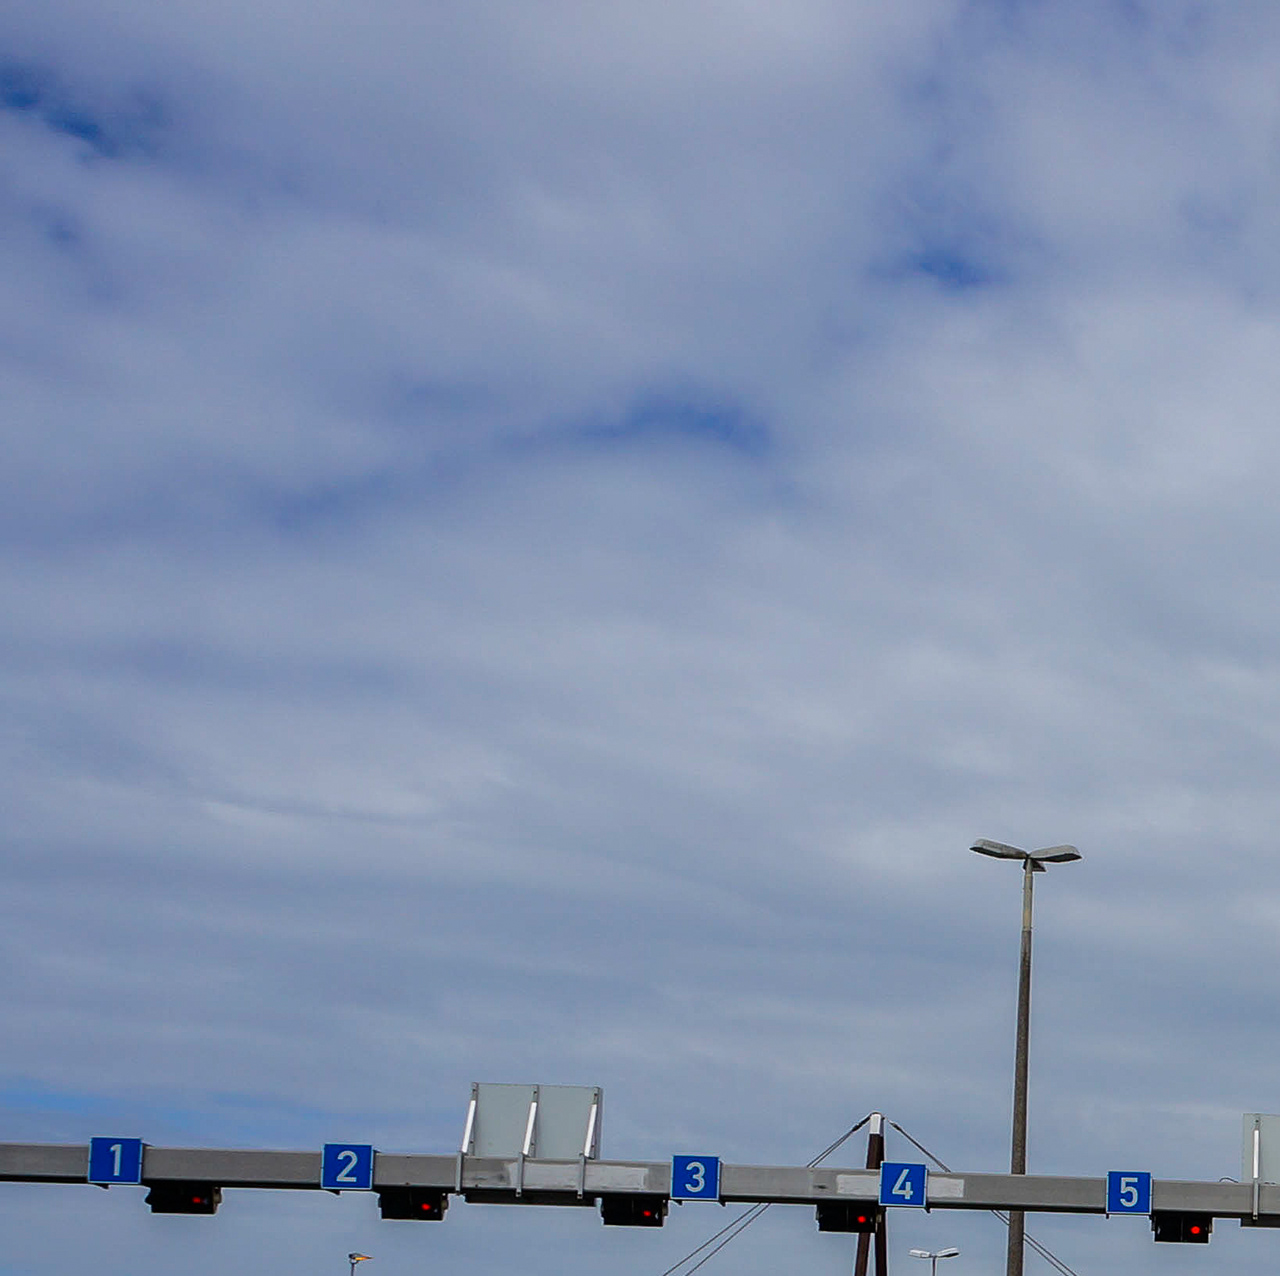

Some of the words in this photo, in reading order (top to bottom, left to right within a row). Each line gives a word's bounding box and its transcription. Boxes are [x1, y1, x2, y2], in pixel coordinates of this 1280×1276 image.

[109, 1144, 122, 1177] 1
[336, 1150, 358, 1183] 2
[685, 1161, 706, 1193] 3
[892, 1168, 914, 1200] 4
[1119, 1177, 1139, 1208] 5
